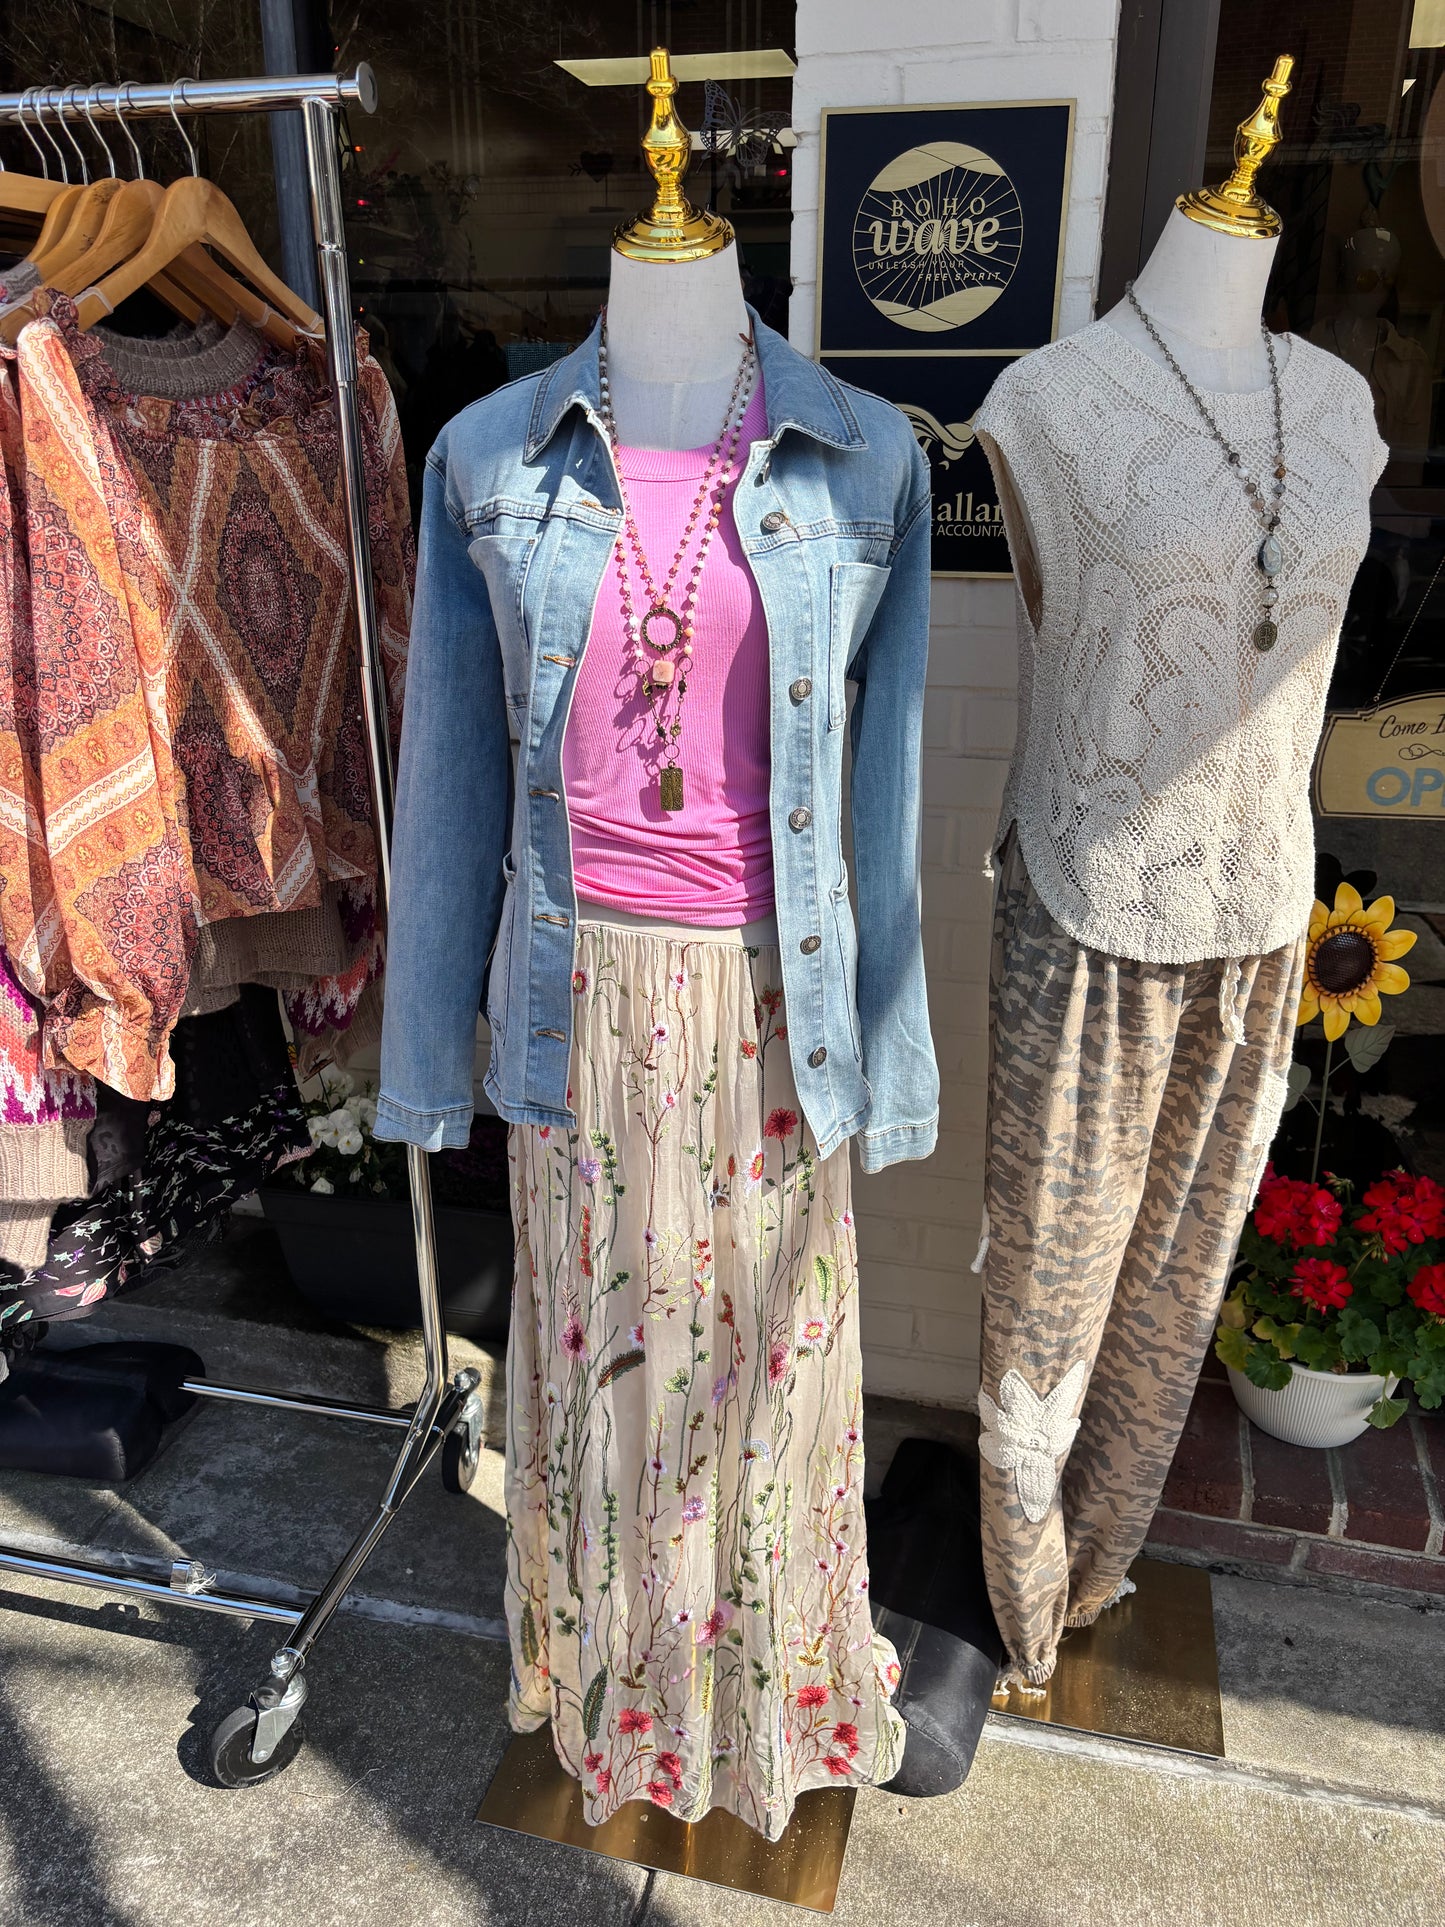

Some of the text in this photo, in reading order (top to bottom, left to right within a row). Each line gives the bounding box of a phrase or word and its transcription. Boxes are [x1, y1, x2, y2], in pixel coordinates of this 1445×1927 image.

[891, 197, 986, 217] BOHO
[868, 217, 1000, 256] wave
[868, 259, 964, 270] UNLEASH YOUR
[917, 271, 1001, 282] FREE SPIRIT
[1379, 714, 1428, 739] Come
[1366, 766, 1445, 808] OP
